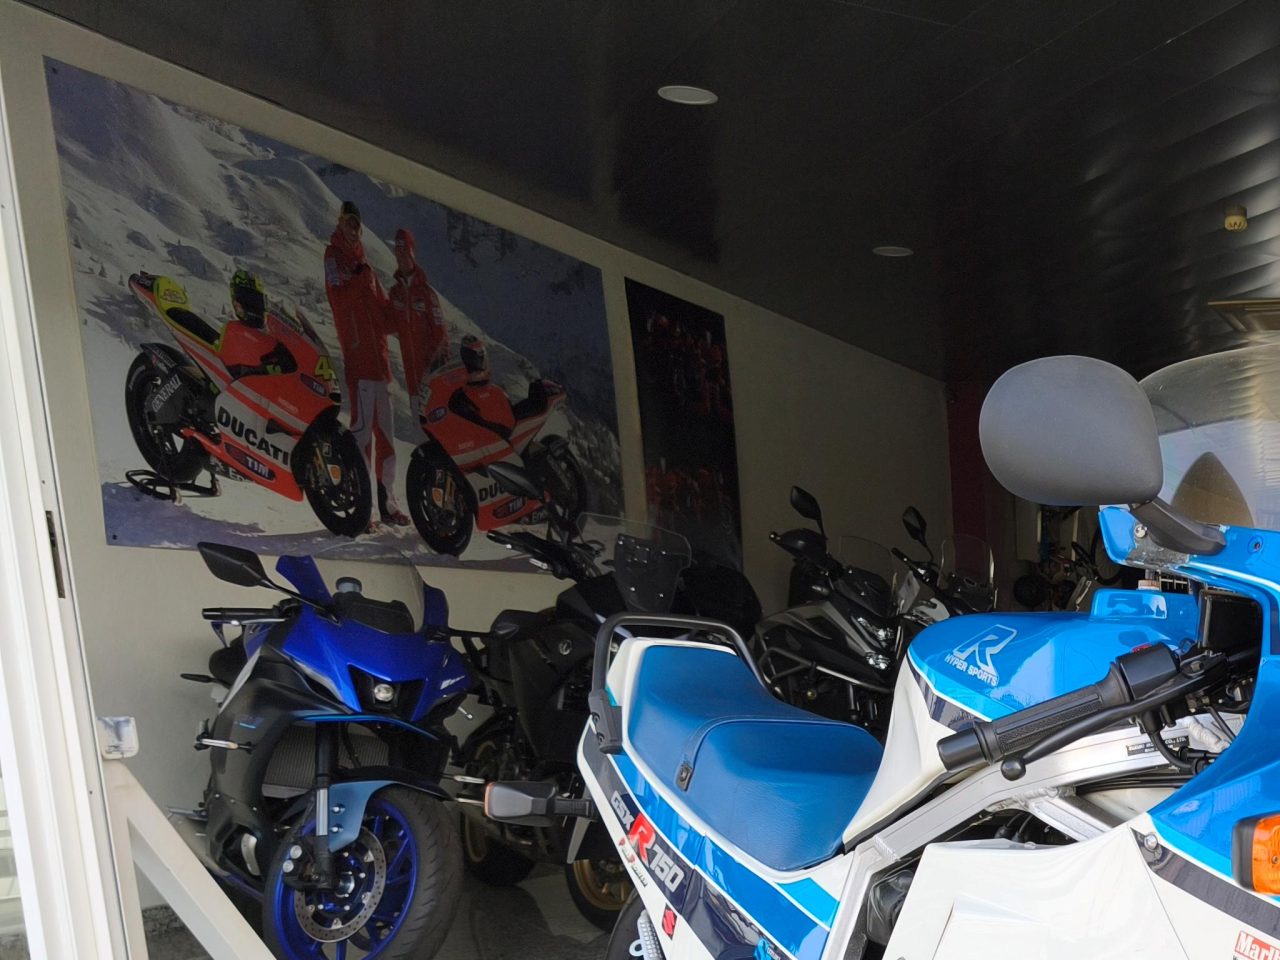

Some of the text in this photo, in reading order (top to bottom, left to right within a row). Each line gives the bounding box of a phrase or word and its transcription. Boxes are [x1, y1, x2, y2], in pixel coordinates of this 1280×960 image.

[217, 406, 290, 466] DUCATI
[246, 456, 270, 478] TIM
[944, 653, 998, 687] HYPER SPORTS
